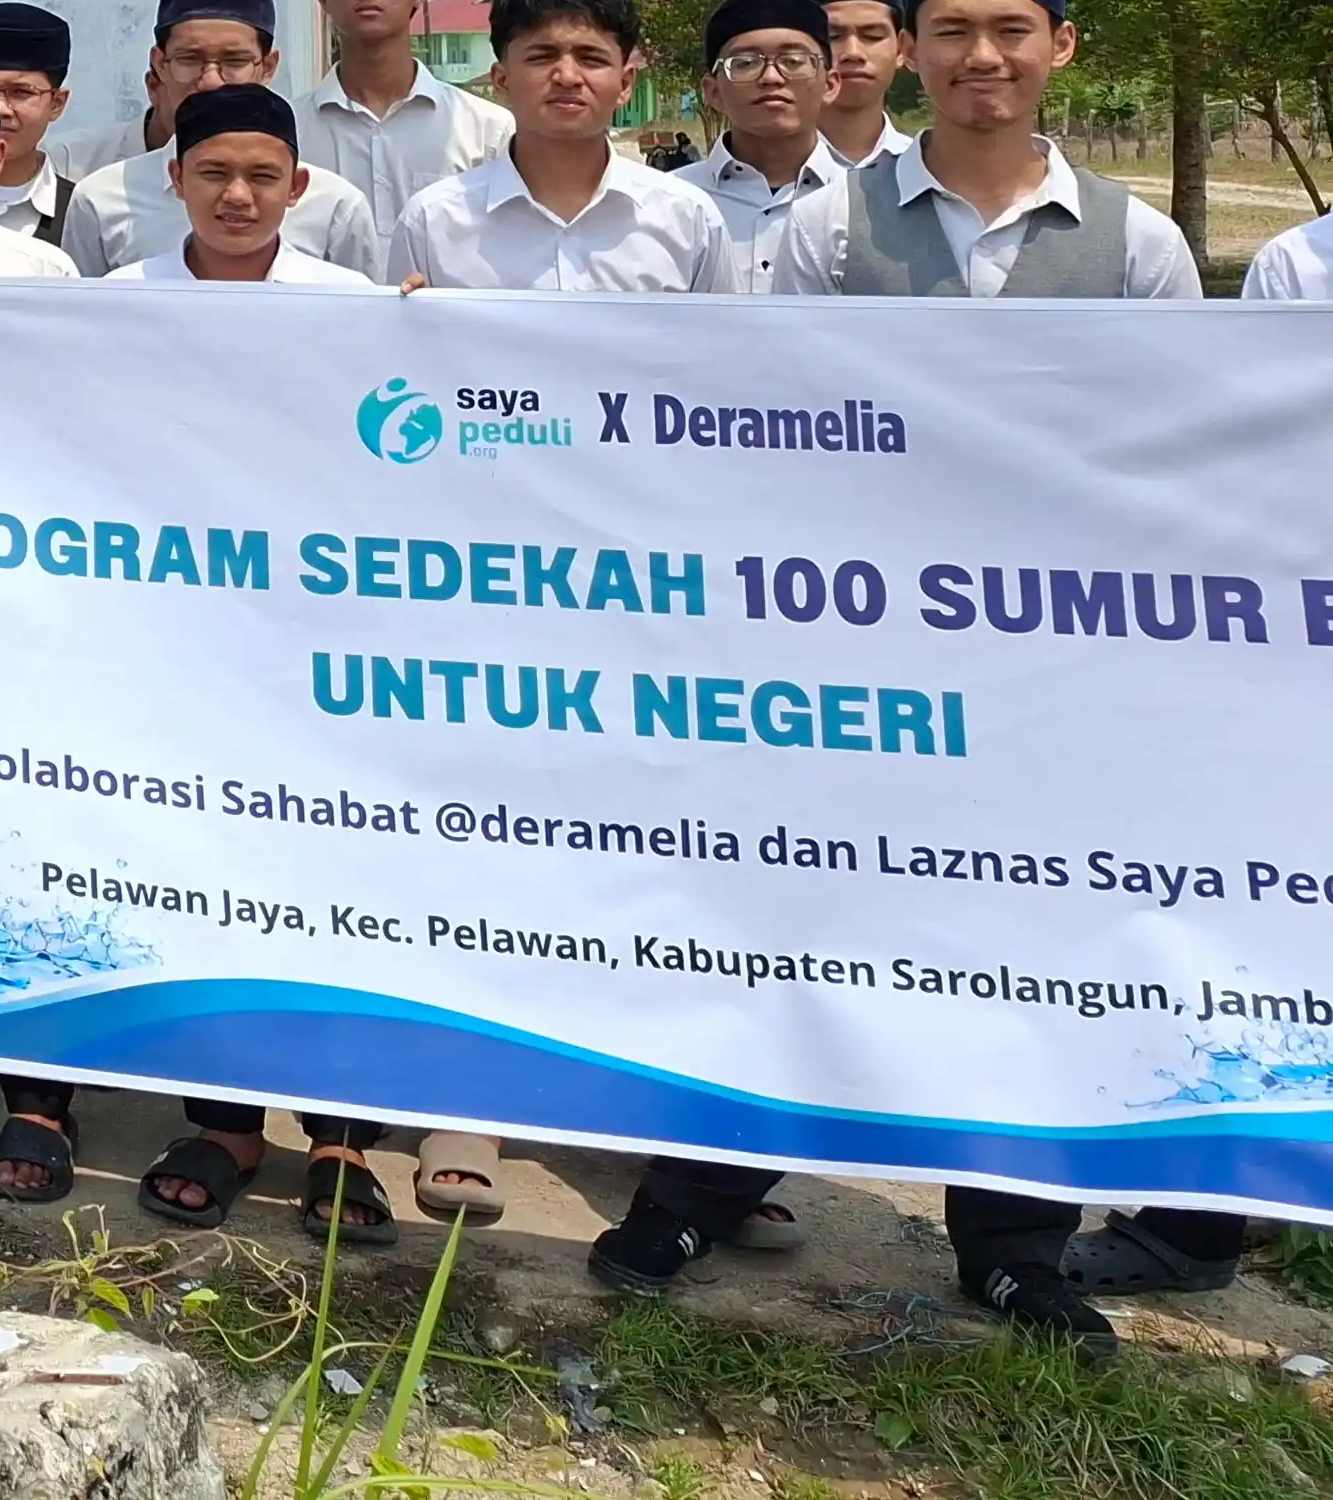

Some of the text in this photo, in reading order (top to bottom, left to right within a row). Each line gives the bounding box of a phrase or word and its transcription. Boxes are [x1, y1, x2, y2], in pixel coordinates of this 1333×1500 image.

[457, 388, 539, 416] saya
[459, 417, 572, 455] peduli
[598, 392, 906, 453] X Deramelia
[300, 534, 705, 616] SEDEKAH
[736, 557, 886, 625] 100
[920, 564, 1269, 643] SUMUR
[313, 652, 966, 757] UNTUK NEGERI
[222, 781, 420, 834] Sahabat
[436, 803, 739, 861] @deramelia
[759, 826, 857, 870] dan
[878, 836, 1069, 886] Laznas
[1088, 851, 1224, 907] Saya
[43, 862, 208, 916] Pelawan
[219, 890, 315, 936] Jaya,
[331, 905, 412, 944] Kec.
[428, 916, 618, 969] Pelawan,
[635, 935, 875, 988] Kabupaten
[892, 959, 1183, 1017] Sarolangun,
